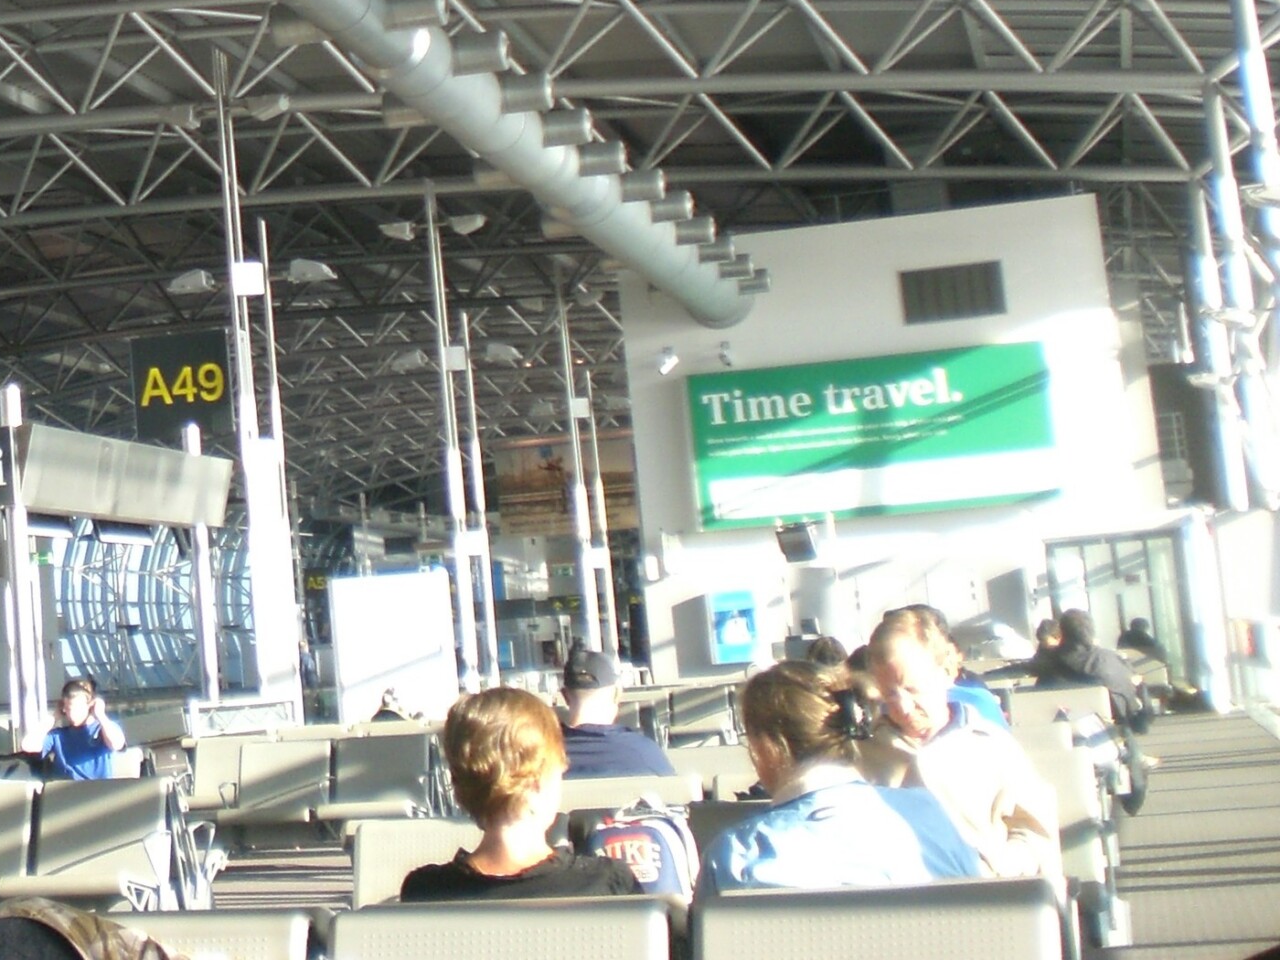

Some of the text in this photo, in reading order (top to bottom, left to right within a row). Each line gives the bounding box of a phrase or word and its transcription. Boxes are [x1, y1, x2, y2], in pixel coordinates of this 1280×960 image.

[141, 362, 224, 407] A49
[701, 367, 963, 425] Time travel.
